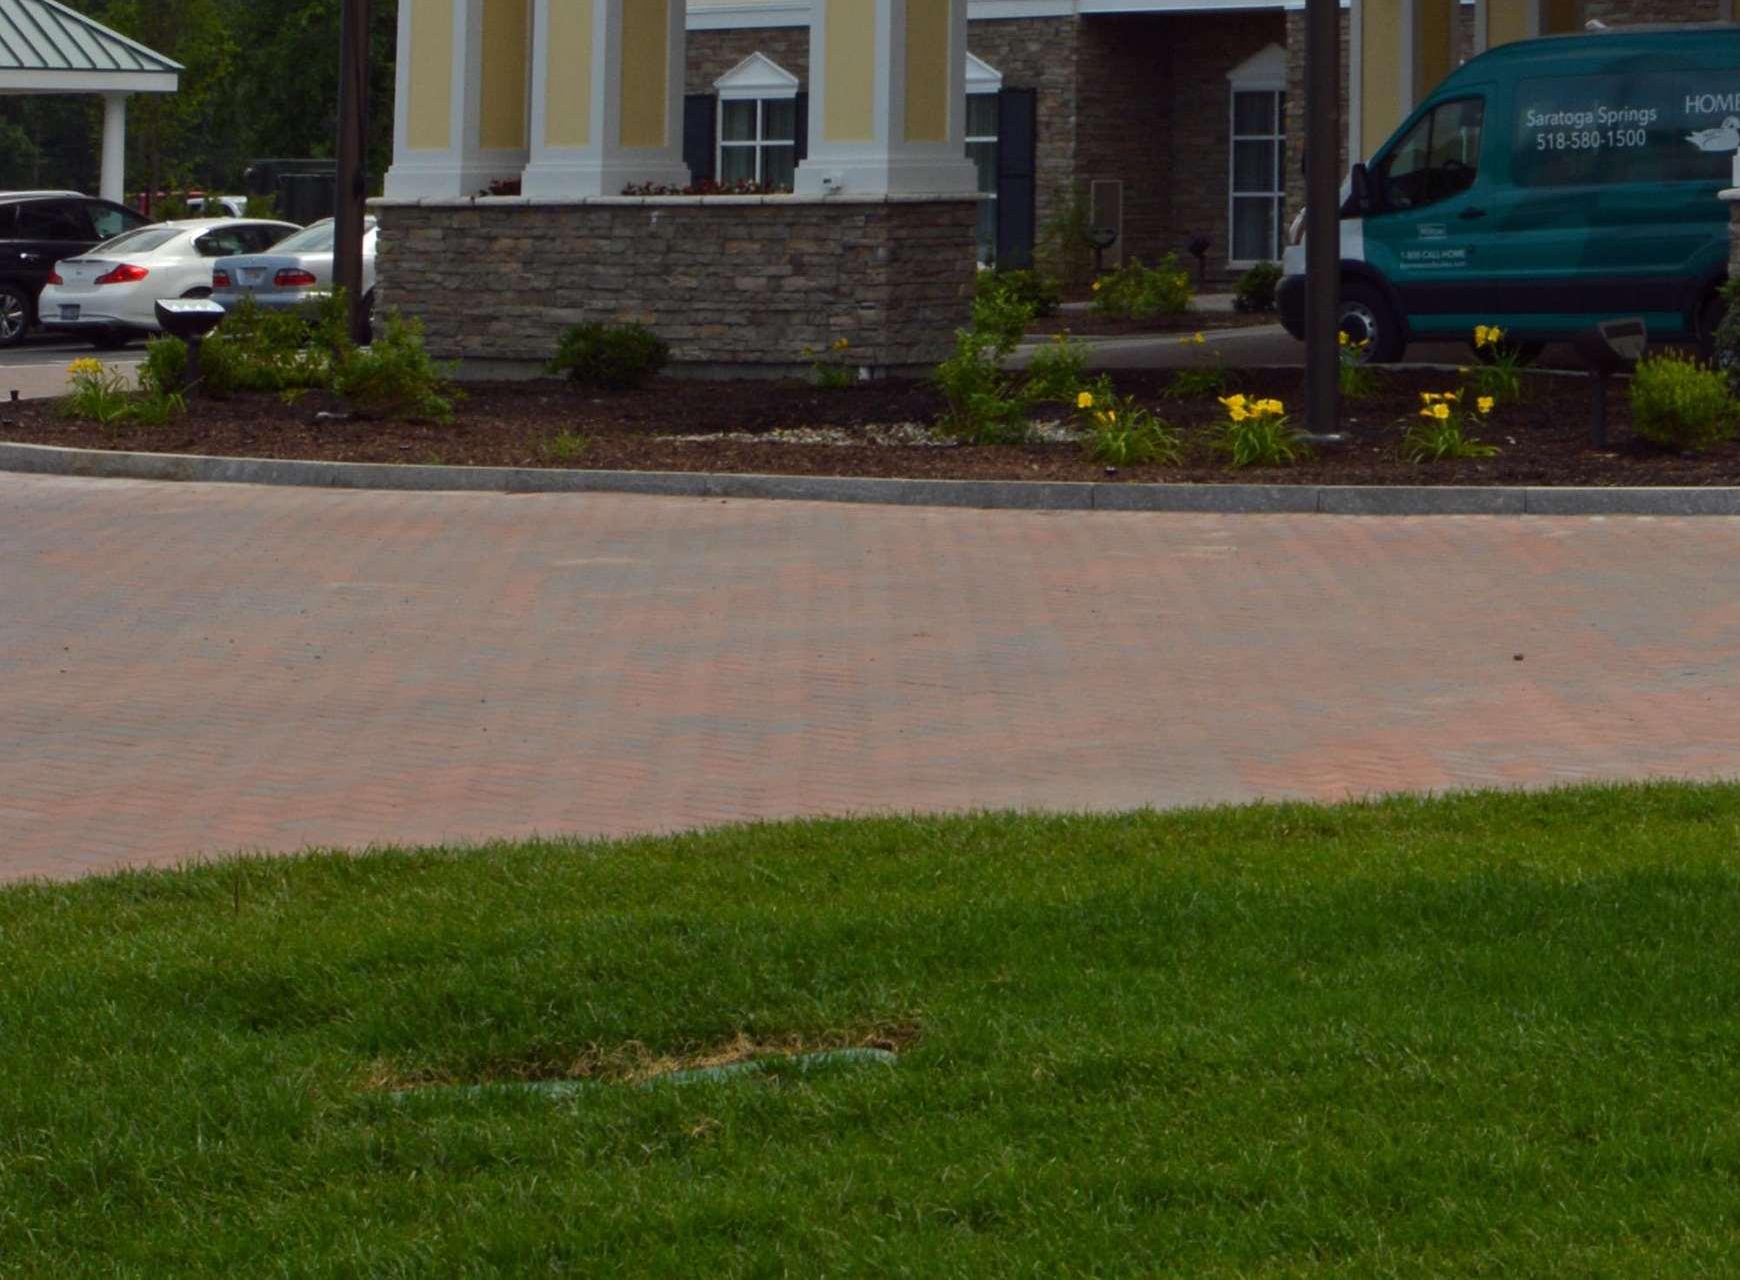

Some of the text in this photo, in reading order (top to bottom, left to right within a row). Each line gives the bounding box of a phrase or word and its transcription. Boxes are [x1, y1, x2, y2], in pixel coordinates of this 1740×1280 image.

[1526, 105, 1657, 128] Saratoga Springs
[1536, 128, 1646, 151] 518-580-1500
